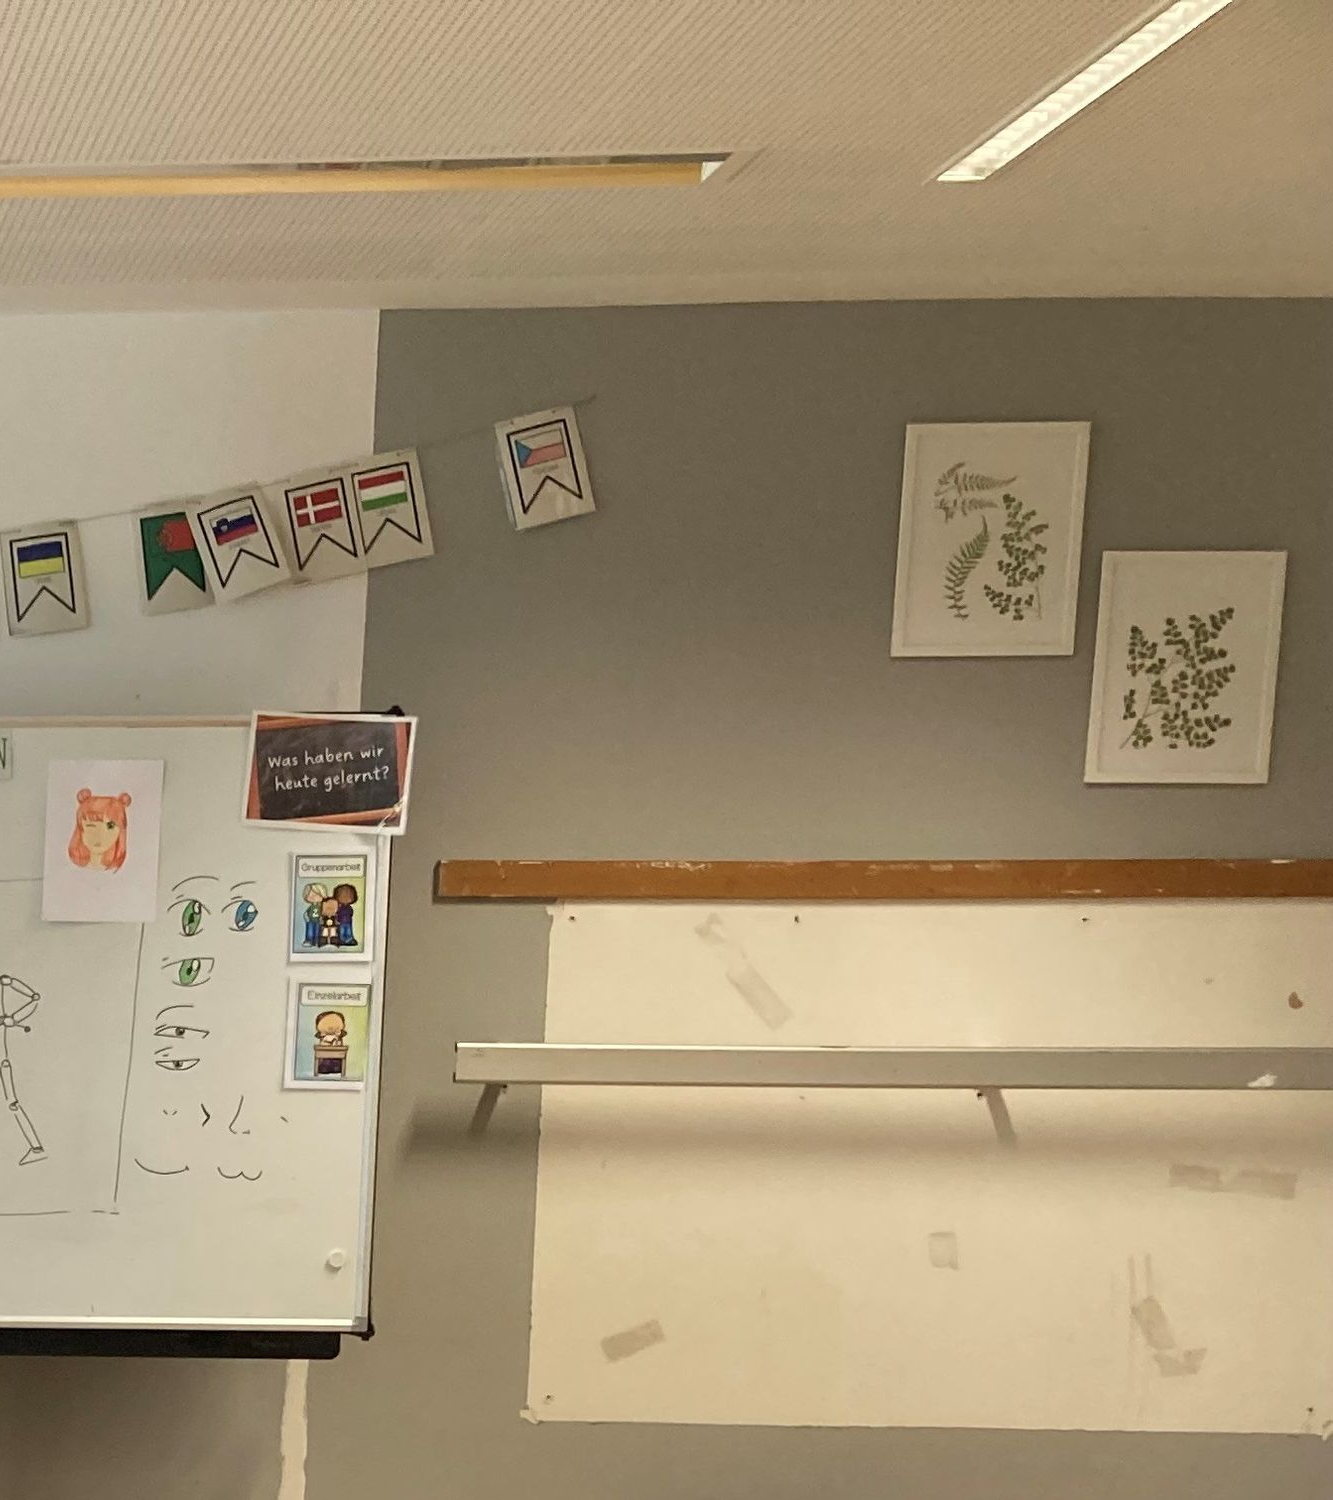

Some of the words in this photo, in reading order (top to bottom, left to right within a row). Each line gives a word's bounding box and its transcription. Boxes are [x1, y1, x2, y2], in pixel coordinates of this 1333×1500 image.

[268, 755, 298, 769] Was
[305, 747, 353, 766] haben
[360, 745, 384, 759] wir
[275, 775, 318, 792] heute
[323, 765, 390, 793] gelernt?
